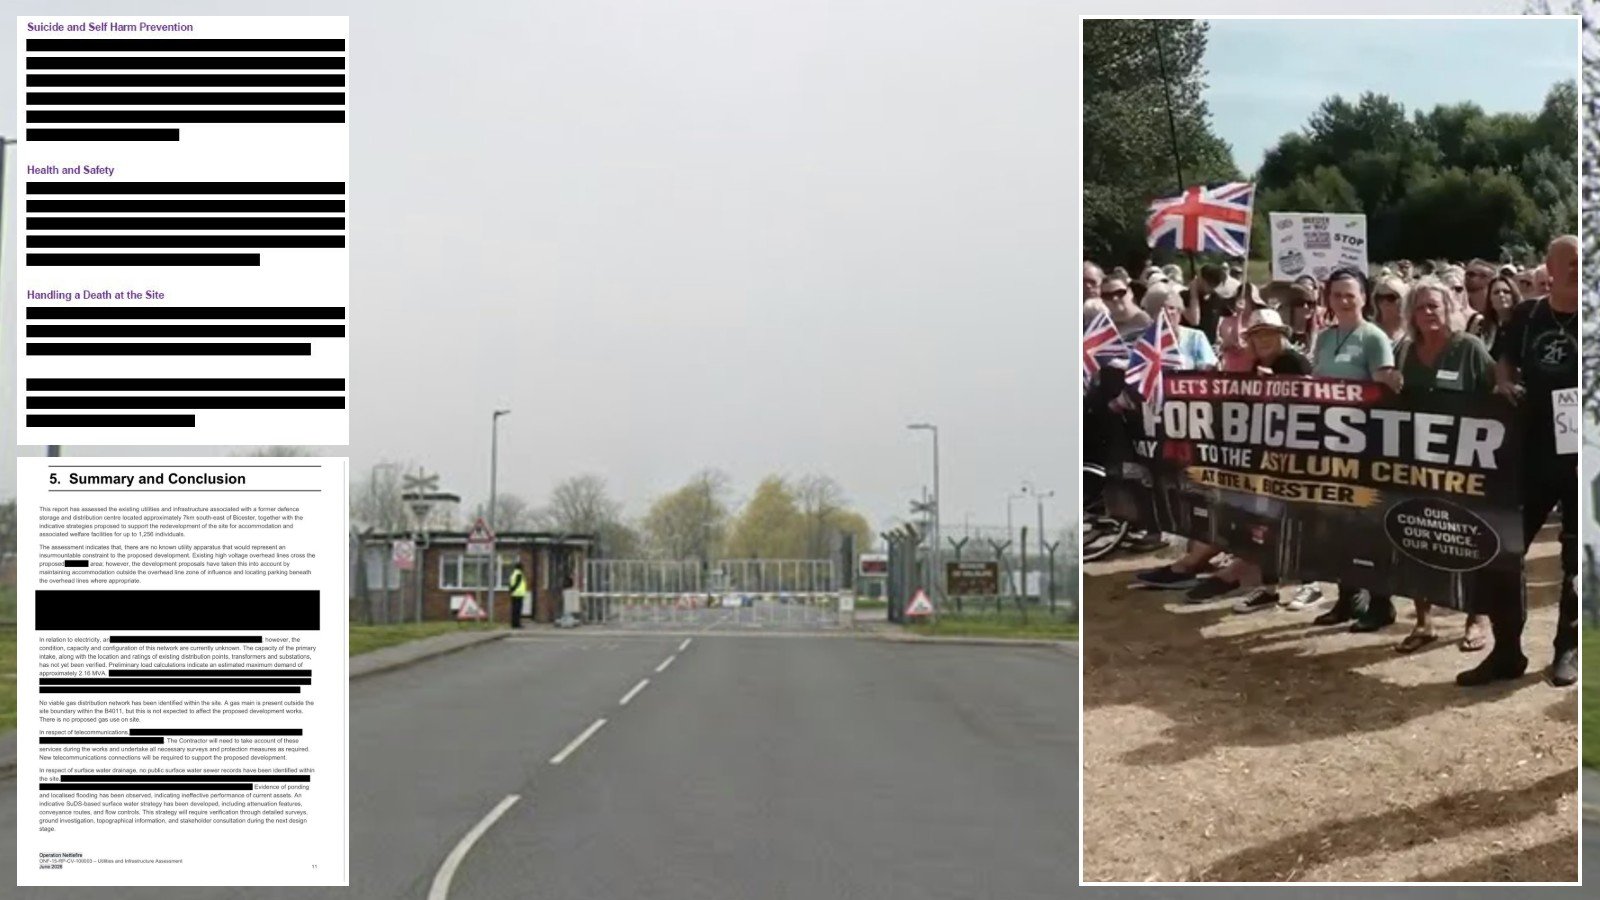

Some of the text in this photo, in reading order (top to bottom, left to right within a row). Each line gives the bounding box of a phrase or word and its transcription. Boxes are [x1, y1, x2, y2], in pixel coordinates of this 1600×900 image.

[27, 22, 193, 32] Suicide and Self Harm Prevention
[28, 165, 115, 176] Health and Safety
[1334, 233, 1364, 246] STOP
[27, 290, 72, 301] Handling
[84, 290, 112, 300] Death
[114, 291, 124, 300] at
[126, 290, 142, 300] the
[145, 290, 164, 300] Site
[1171, 380, 1363, 401] LET'S STAND TOGETHER
[1142, 400, 1505, 469] FOR BICESTER
[1197, 444, 1218, 462] TO
[1221, 446, 1252, 467] THE
[1260, 450, 1359, 480] ASYLUM
[1371, 461, 1486, 496] CENTRE
[50, 472, 246, 487] 5. Summary and Conclusion
[1217, 472, 1240, 488] SITE
[1262, 479, 1354, 502] BICESTER
[1424, 508, 1449, 520] OUR
[1404, 526, 1430, 539] OUR
[1403, 538, 1428, 550] OUR
